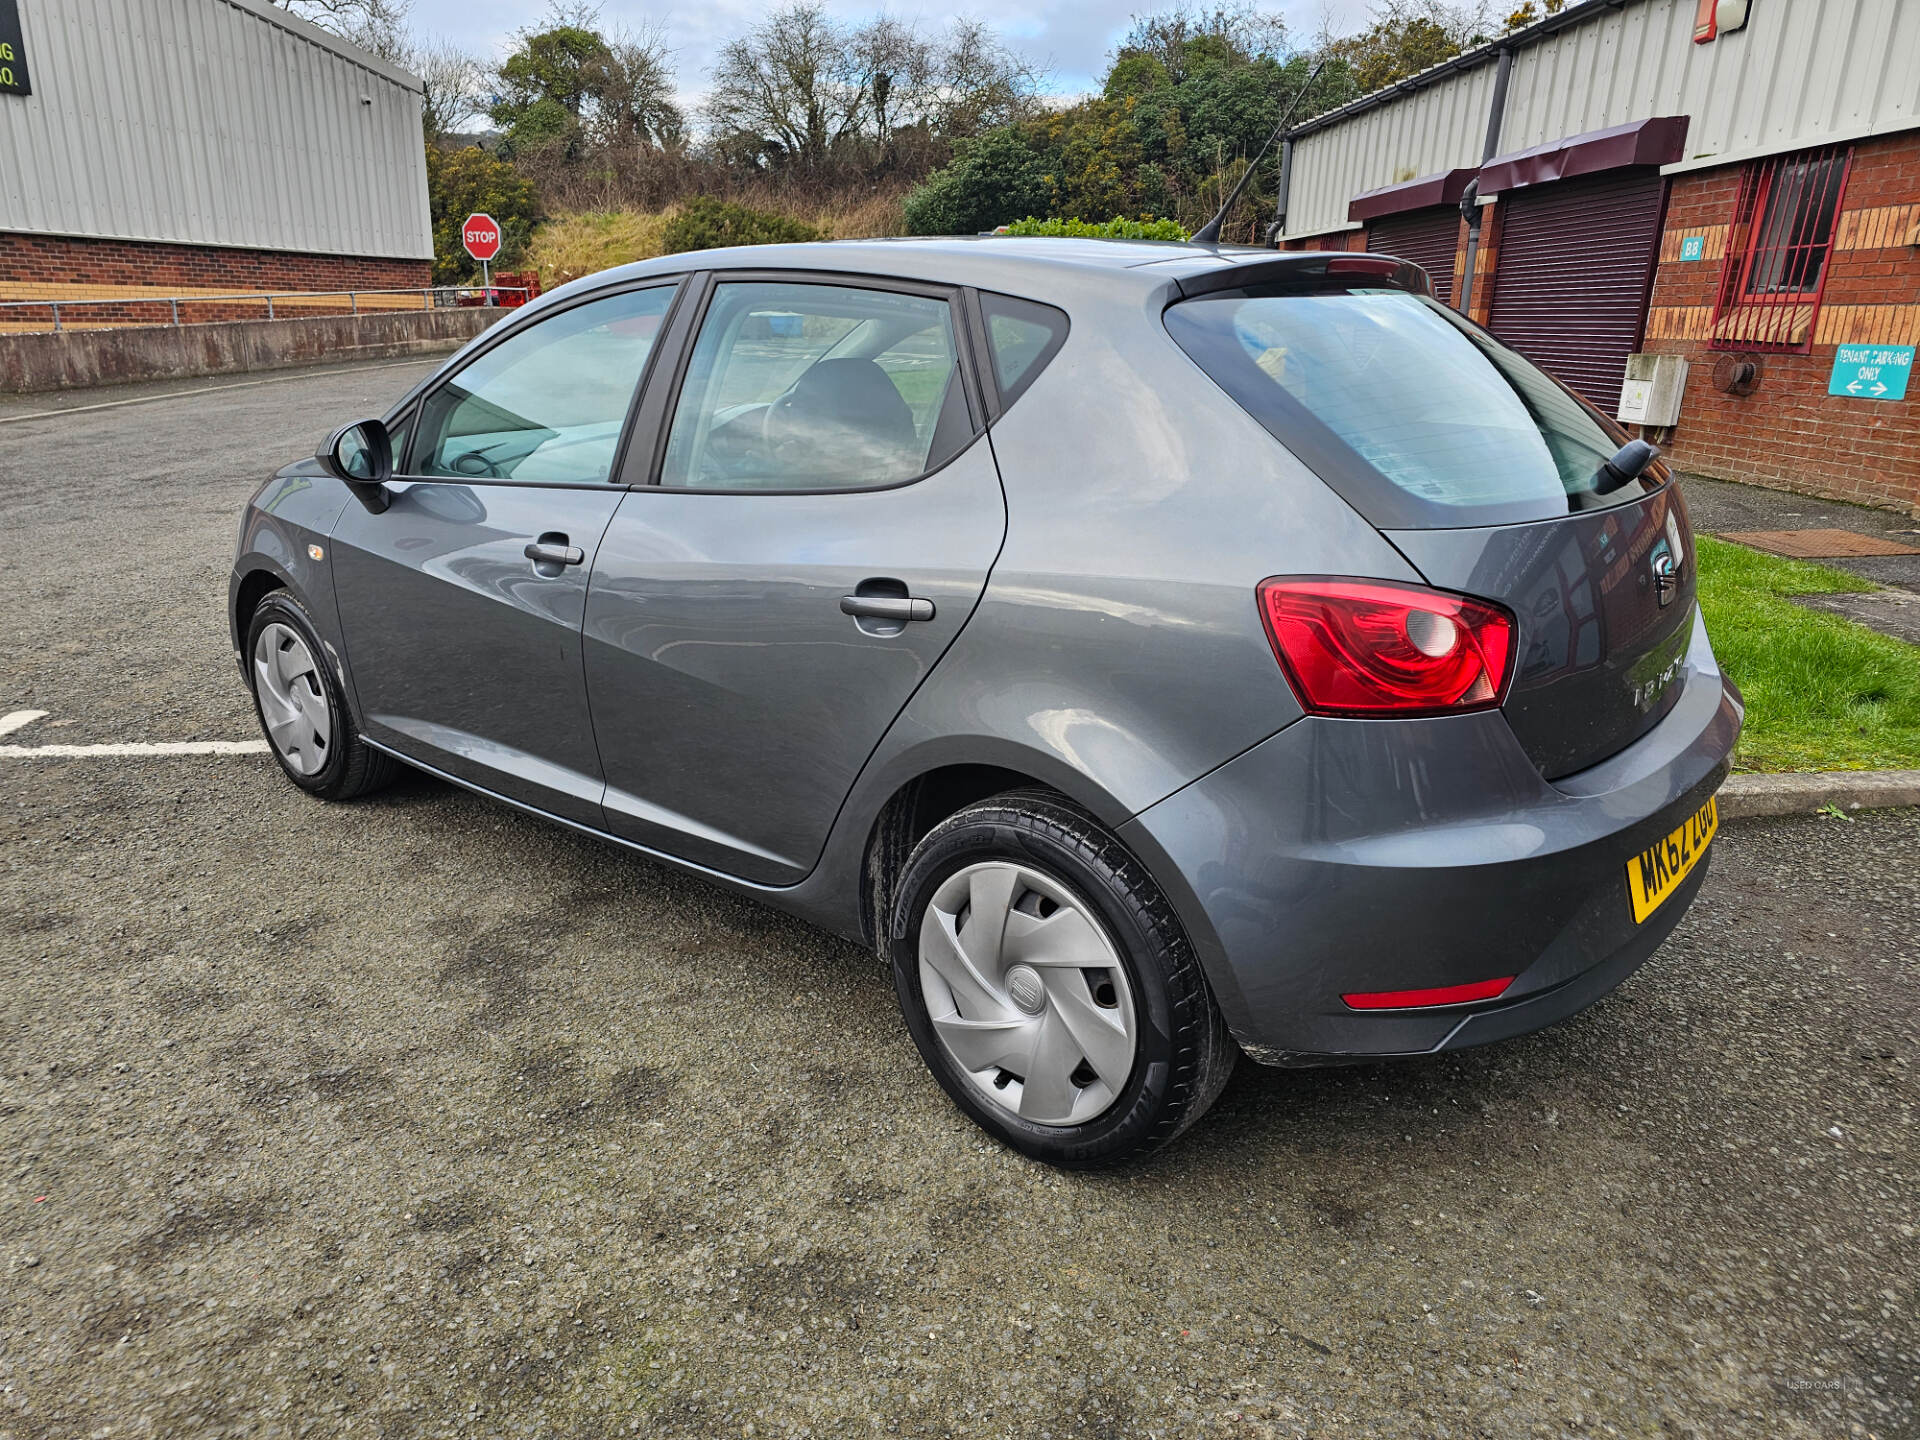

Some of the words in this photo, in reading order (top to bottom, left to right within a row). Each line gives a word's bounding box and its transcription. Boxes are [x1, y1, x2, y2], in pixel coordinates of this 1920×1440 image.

[0, 42, 14, 61] G
[0, 67, 19, 86] O.
[466, 231, 496, 243] STOP
[1839, 349, 1870, 363] TENANT
[1870, 351, 1910, 366] PARKING
[1858, 366, 1881, 381] ONLY
[1639, 823, 1690, 904] MK62
